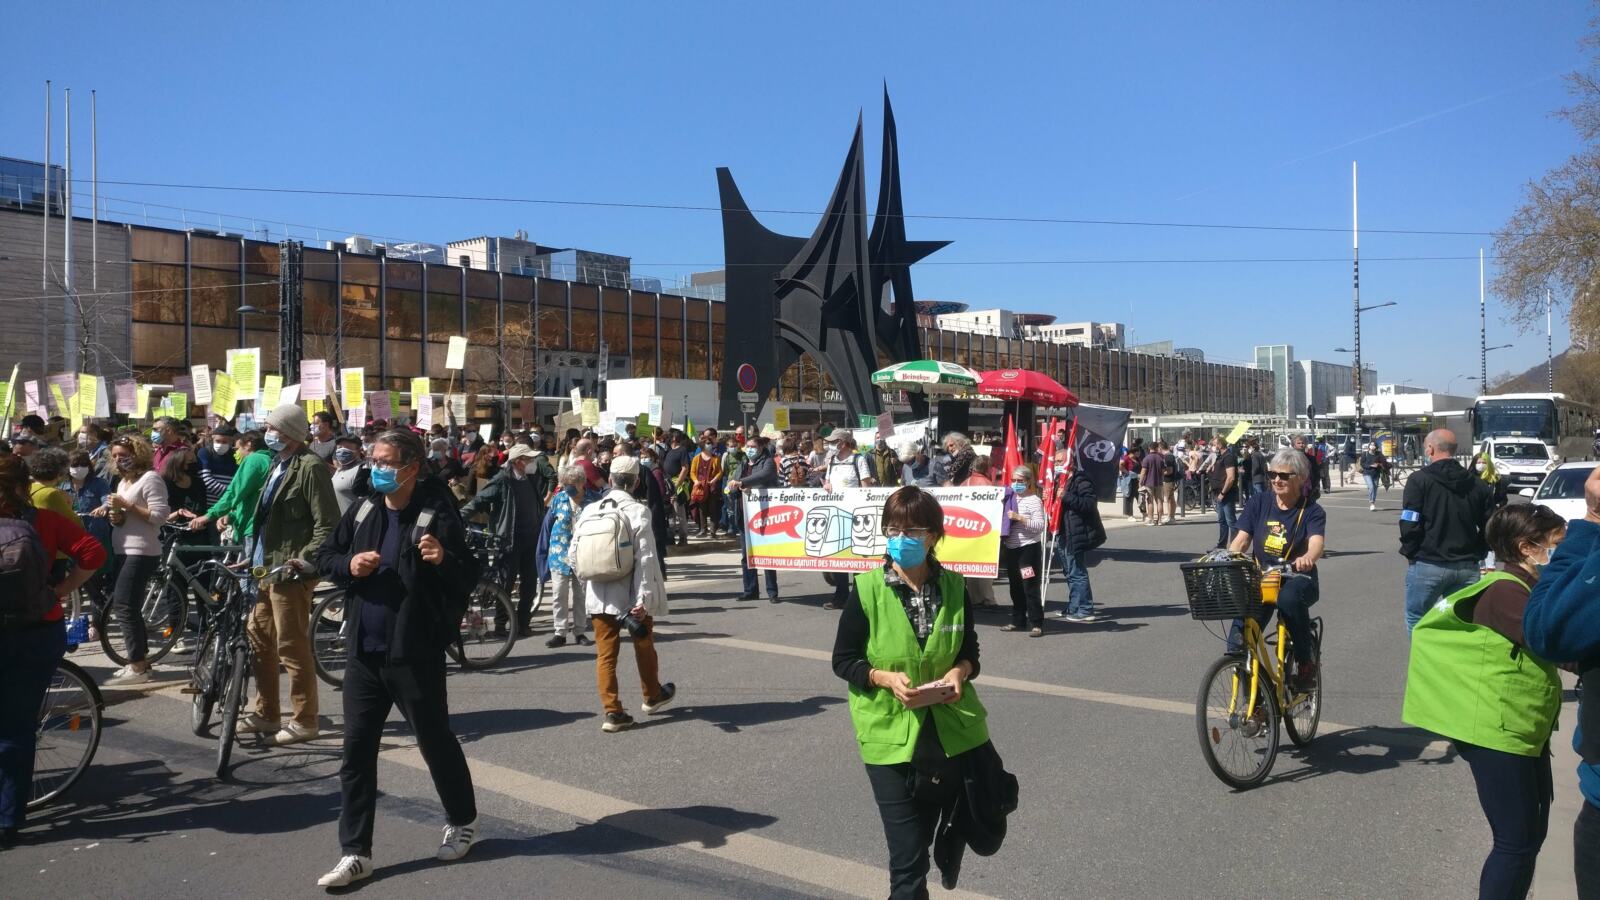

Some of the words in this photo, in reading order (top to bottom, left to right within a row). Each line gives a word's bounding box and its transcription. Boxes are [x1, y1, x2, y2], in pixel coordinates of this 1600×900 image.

[747, 491, 773, 502] Liberté
[780, 490, 806, 504] Égalité
[812, 490, 845, 502] Gratuité
[936, 492, 963, 502] ement
[752, 511, 792, 529] GRATUIT
[956, 516, 979, 531] OUI
[818, 559, 829, 568] DES
[829, 560, 866, 569] TRANSPORTS
[954, 563, 996, 574] GRENOBLOISE
